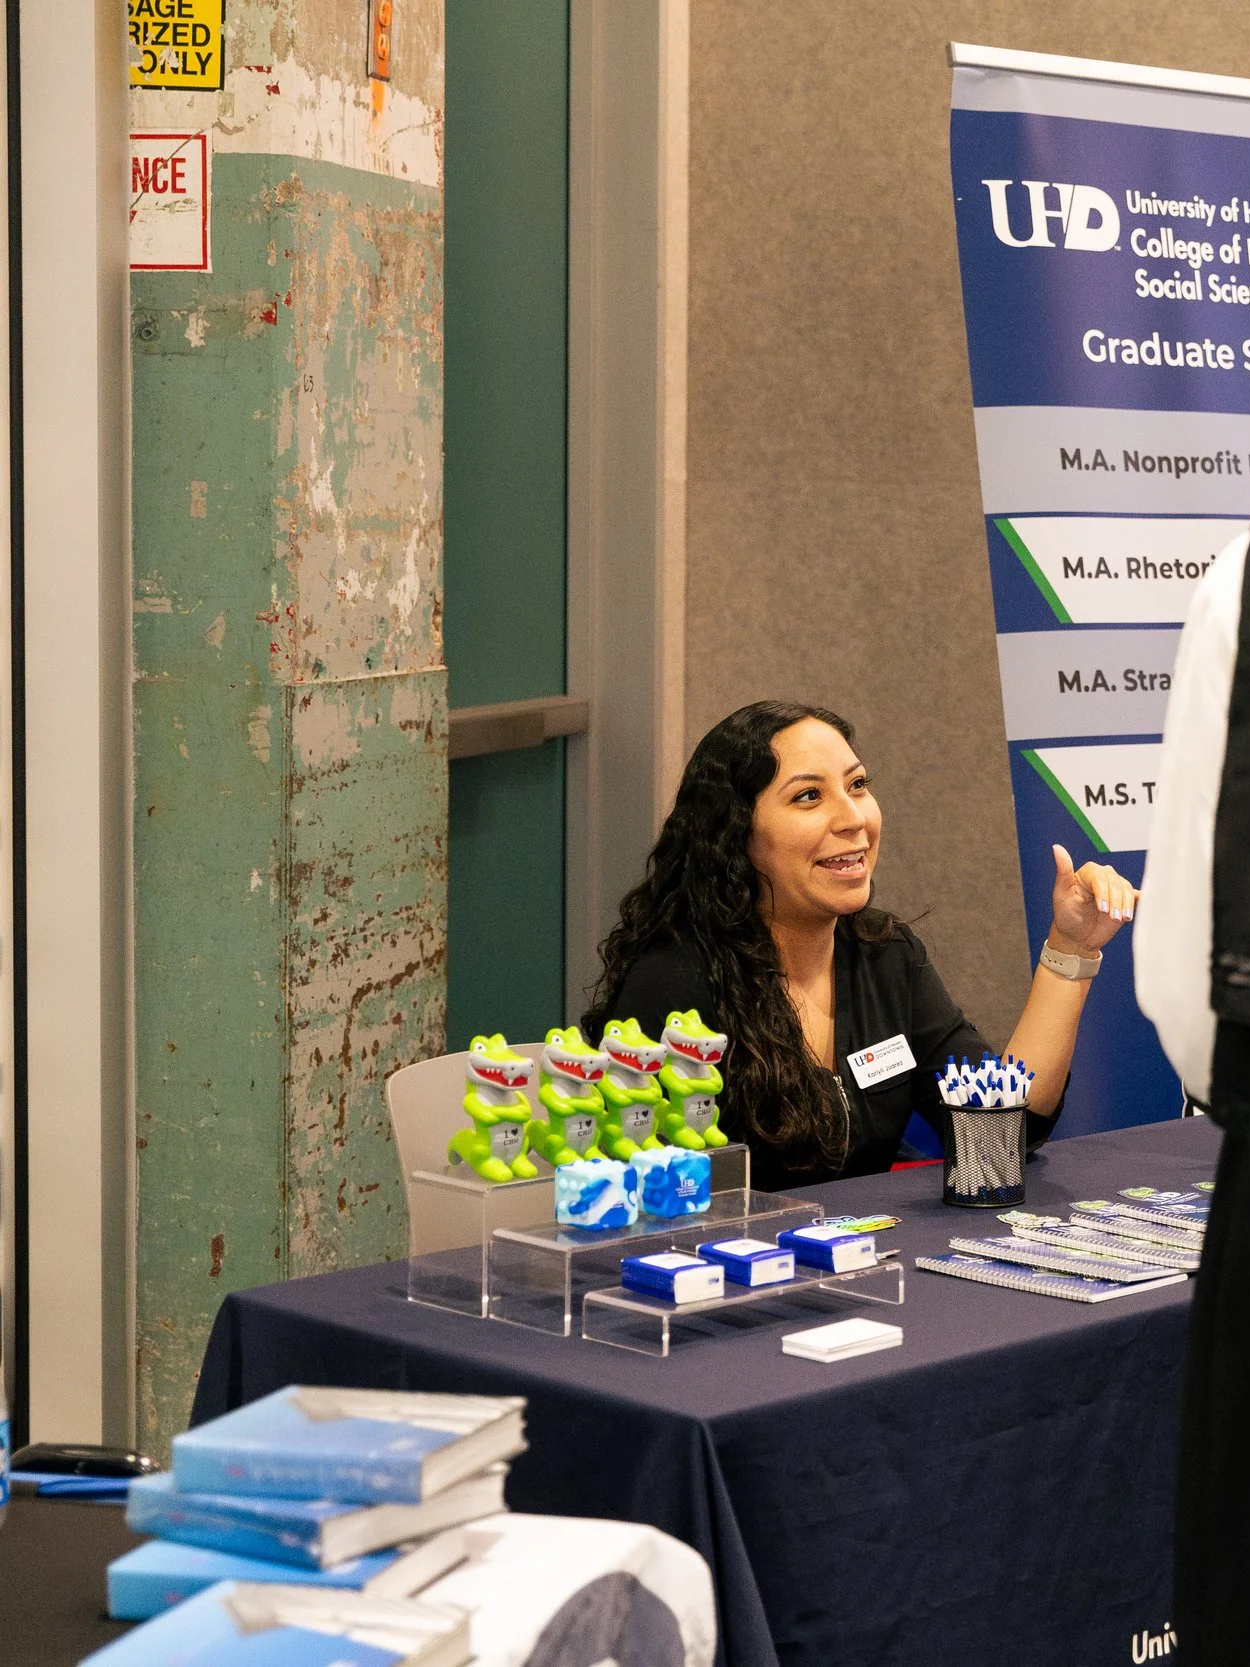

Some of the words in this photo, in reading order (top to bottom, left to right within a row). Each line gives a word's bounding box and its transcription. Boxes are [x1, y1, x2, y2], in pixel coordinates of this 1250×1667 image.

[132, 157, 186, 194] NCE
[981, 180, 1120, 252] UHD
[1126, 189, 1216, 227] University
[1220, 197, 1240, 222] of
[1130, 227, 1214, 269] College
[1219, 233, 1242, 264] of
[1135, 268, 1203, 301] Social
[1082, 329, 1235, 369] Graduate
[1060, 447, 1116, 471] M.A.
[1123, 449, 1243, 479] Nonprofit
[1062, 556, 1119, 579] M.A.
[1058, 669, 1117, 693] M.A.
[1123, 668, 1171, 692] Stra
[1085, 782, 1136, 807] M.S.
